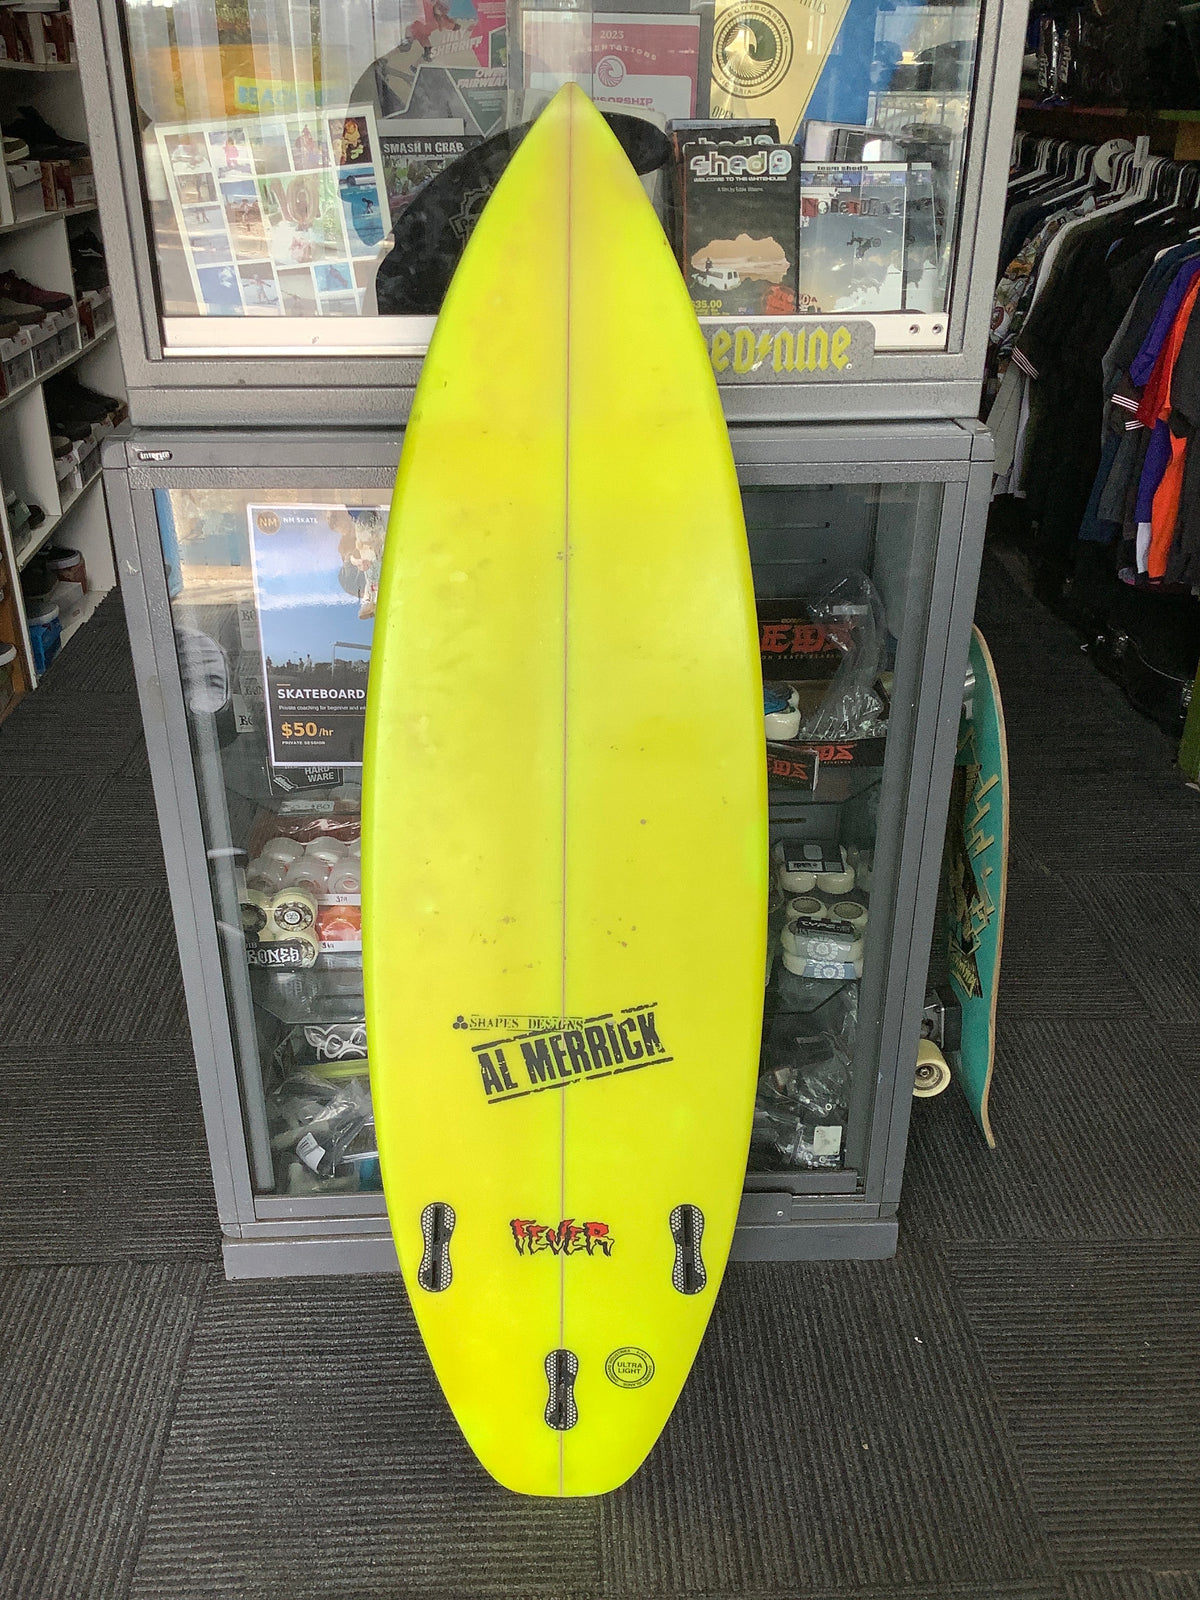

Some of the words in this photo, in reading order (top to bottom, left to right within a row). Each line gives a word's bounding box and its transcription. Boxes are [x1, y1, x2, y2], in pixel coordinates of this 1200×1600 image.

[600, 30, 624, 40] 2023
[457, 78, 507, 89] FAIRWEAT
[383, 143, 421, 153] SMASH
[425, 143, 432, 153] N
[435, 142, 464, 153] GRAB
[260, 518, 277, 528] NM
[277, 689, 366, 699] SKATEBOARD
[307, 772, 334, 782] WARE
[469, 1018, 519, 1029] SHAPES
[528, 1018, 584, 1031] DESIGNS
[478, 1049, 518, 1096] AL
[520, 1011, 666, 1085] MERRICK
[510, 1218, 615, 1257] FEVER
